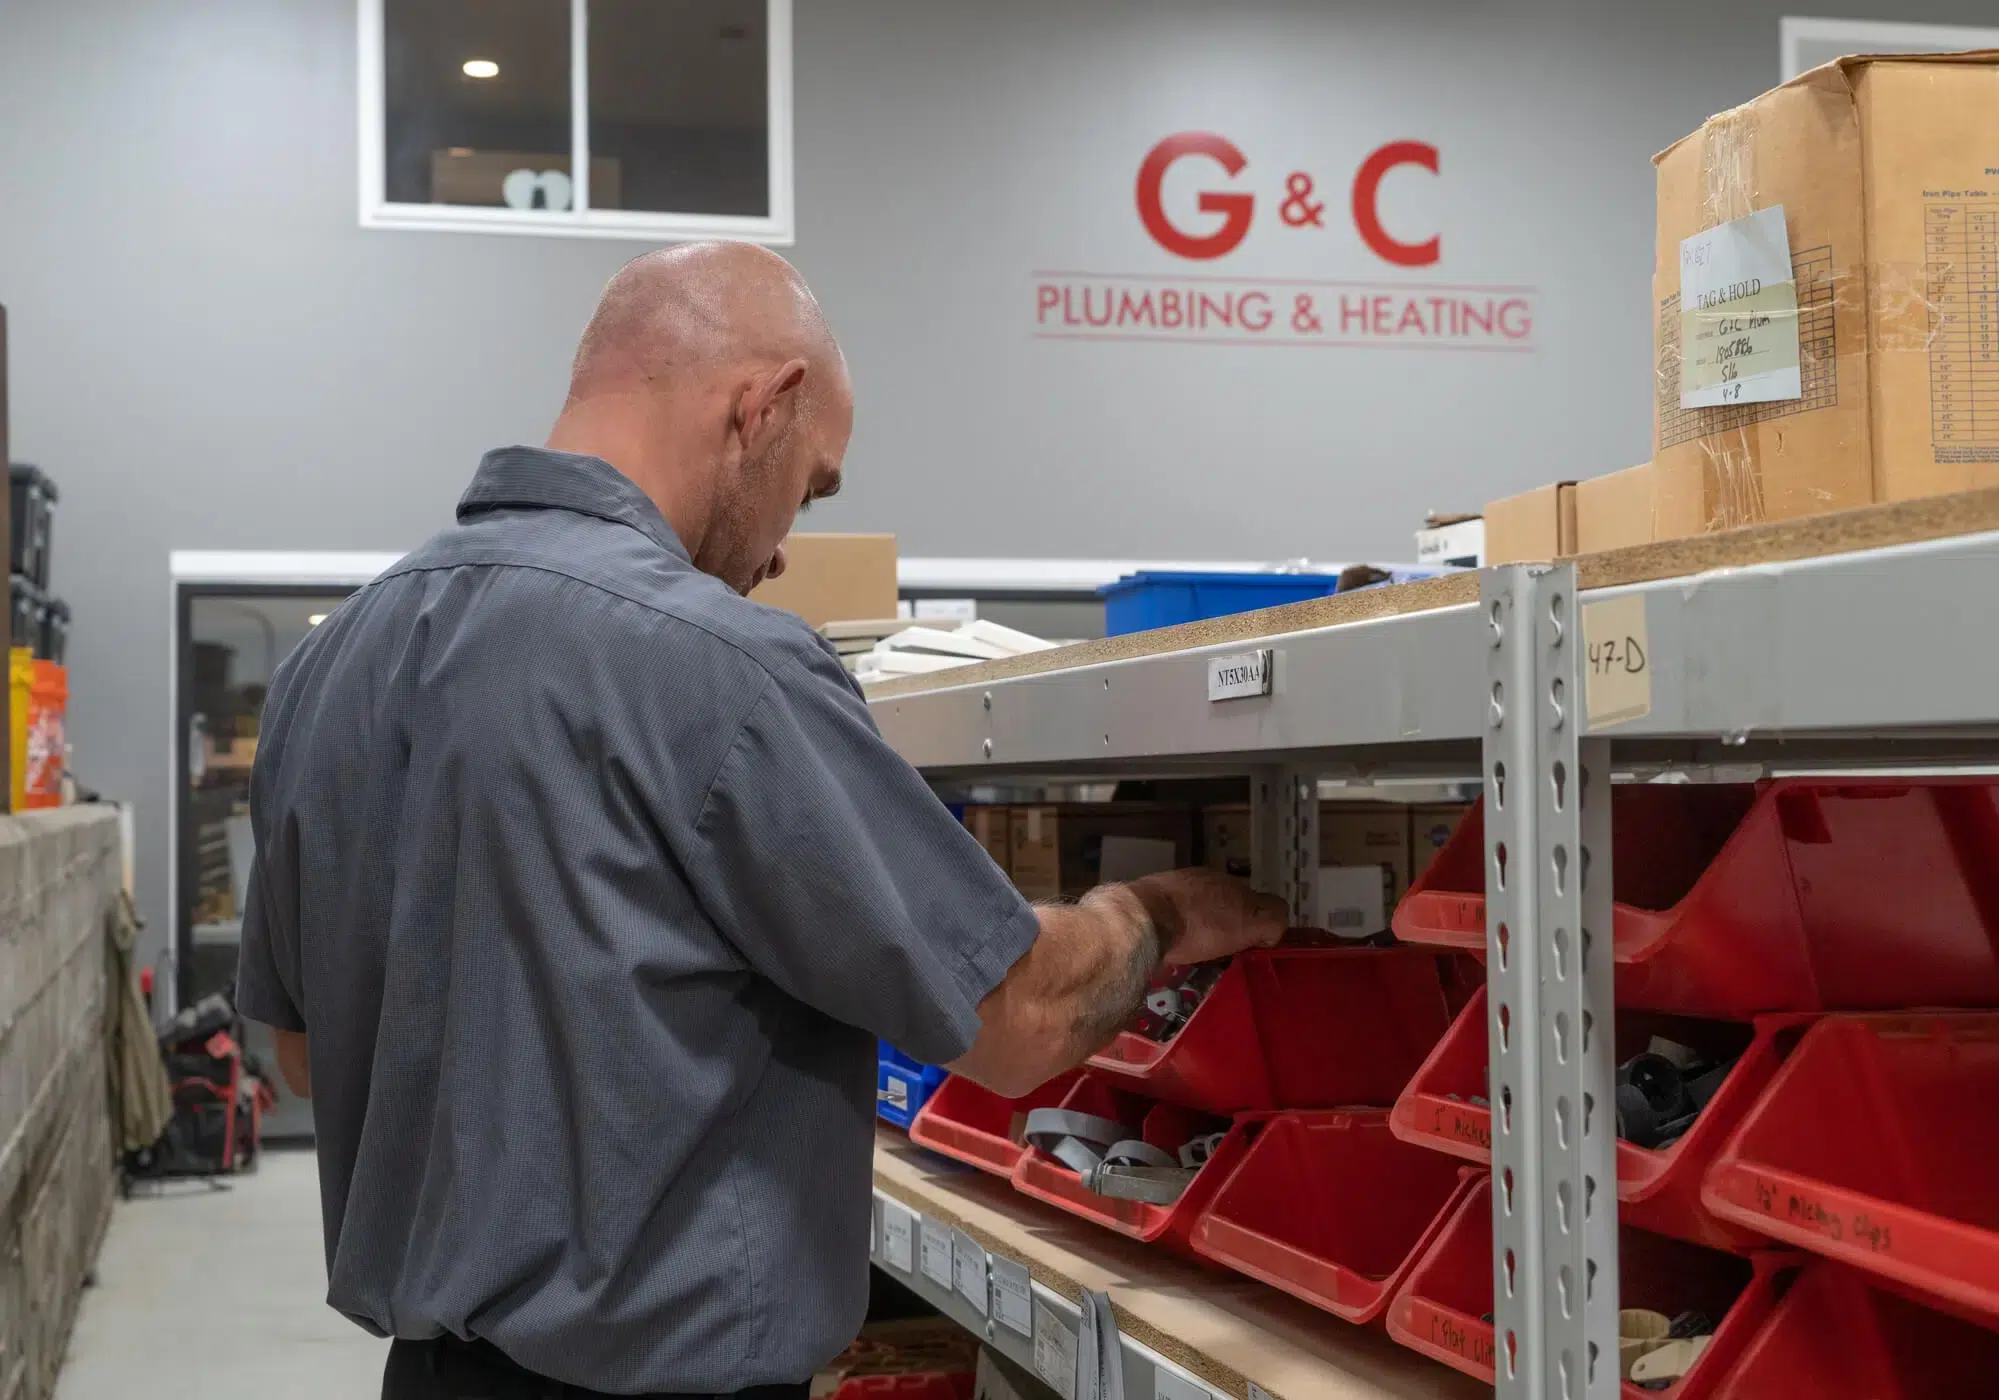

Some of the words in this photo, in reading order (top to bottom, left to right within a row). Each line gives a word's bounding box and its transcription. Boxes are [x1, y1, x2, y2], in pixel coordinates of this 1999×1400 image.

[1135, 130, 1255, 261] G
[1279, 171, 1325, 228] &
[1351, 139, 1441, 267] C
[1035, 283, 1274, 333] PLUMBING
[1290, 293, 1324, 333] &
[1340, 297, 1534, 340] HEATING
[1697, 290, 1716, 311] TAG
[1718, 287, 1727, 305] &
[1728, 278, 1761, 301] HOLD
[1588, 635, 1646, 675] 47-D
